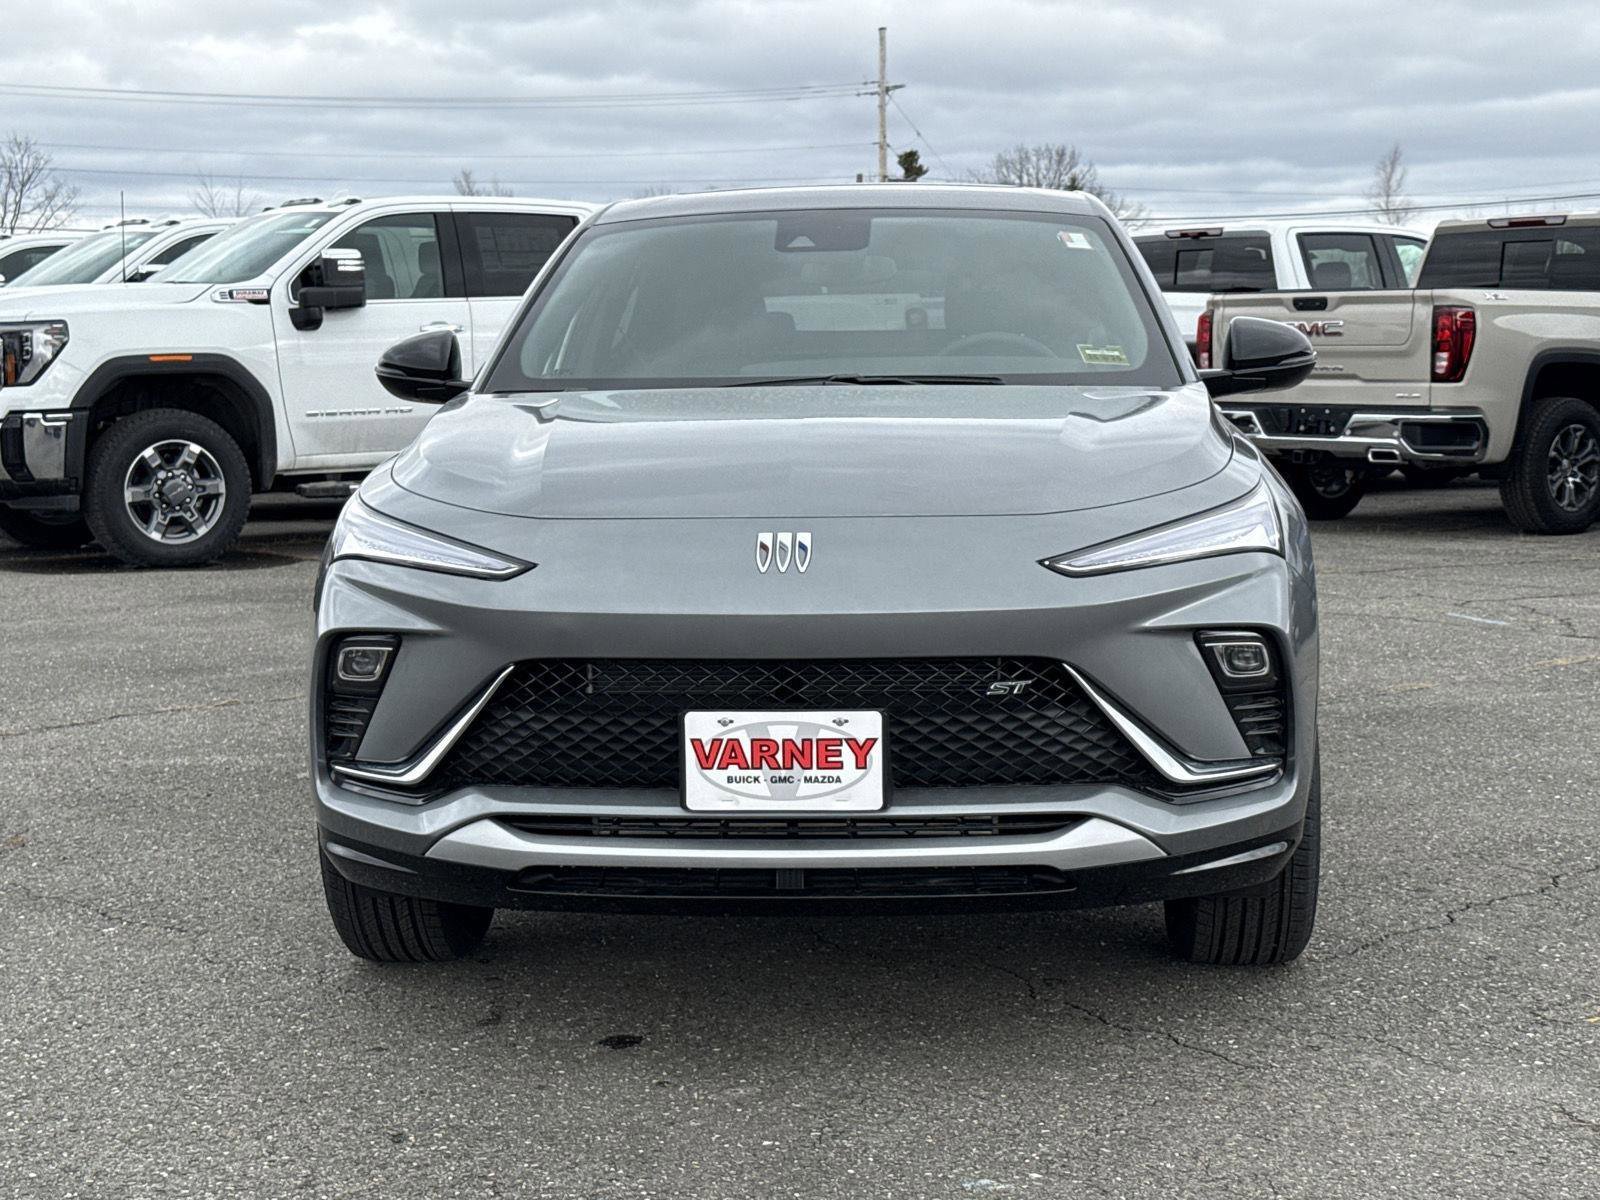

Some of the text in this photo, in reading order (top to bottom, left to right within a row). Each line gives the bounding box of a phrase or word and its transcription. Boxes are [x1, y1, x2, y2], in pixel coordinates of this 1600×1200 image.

[1285, 321, 1344, 336] MC
[987, 680, 1032, 695] ST
[690, 737, 878, 770] VARNEY
[727, 775, 842, 784] BUICK GMC MAZDA
